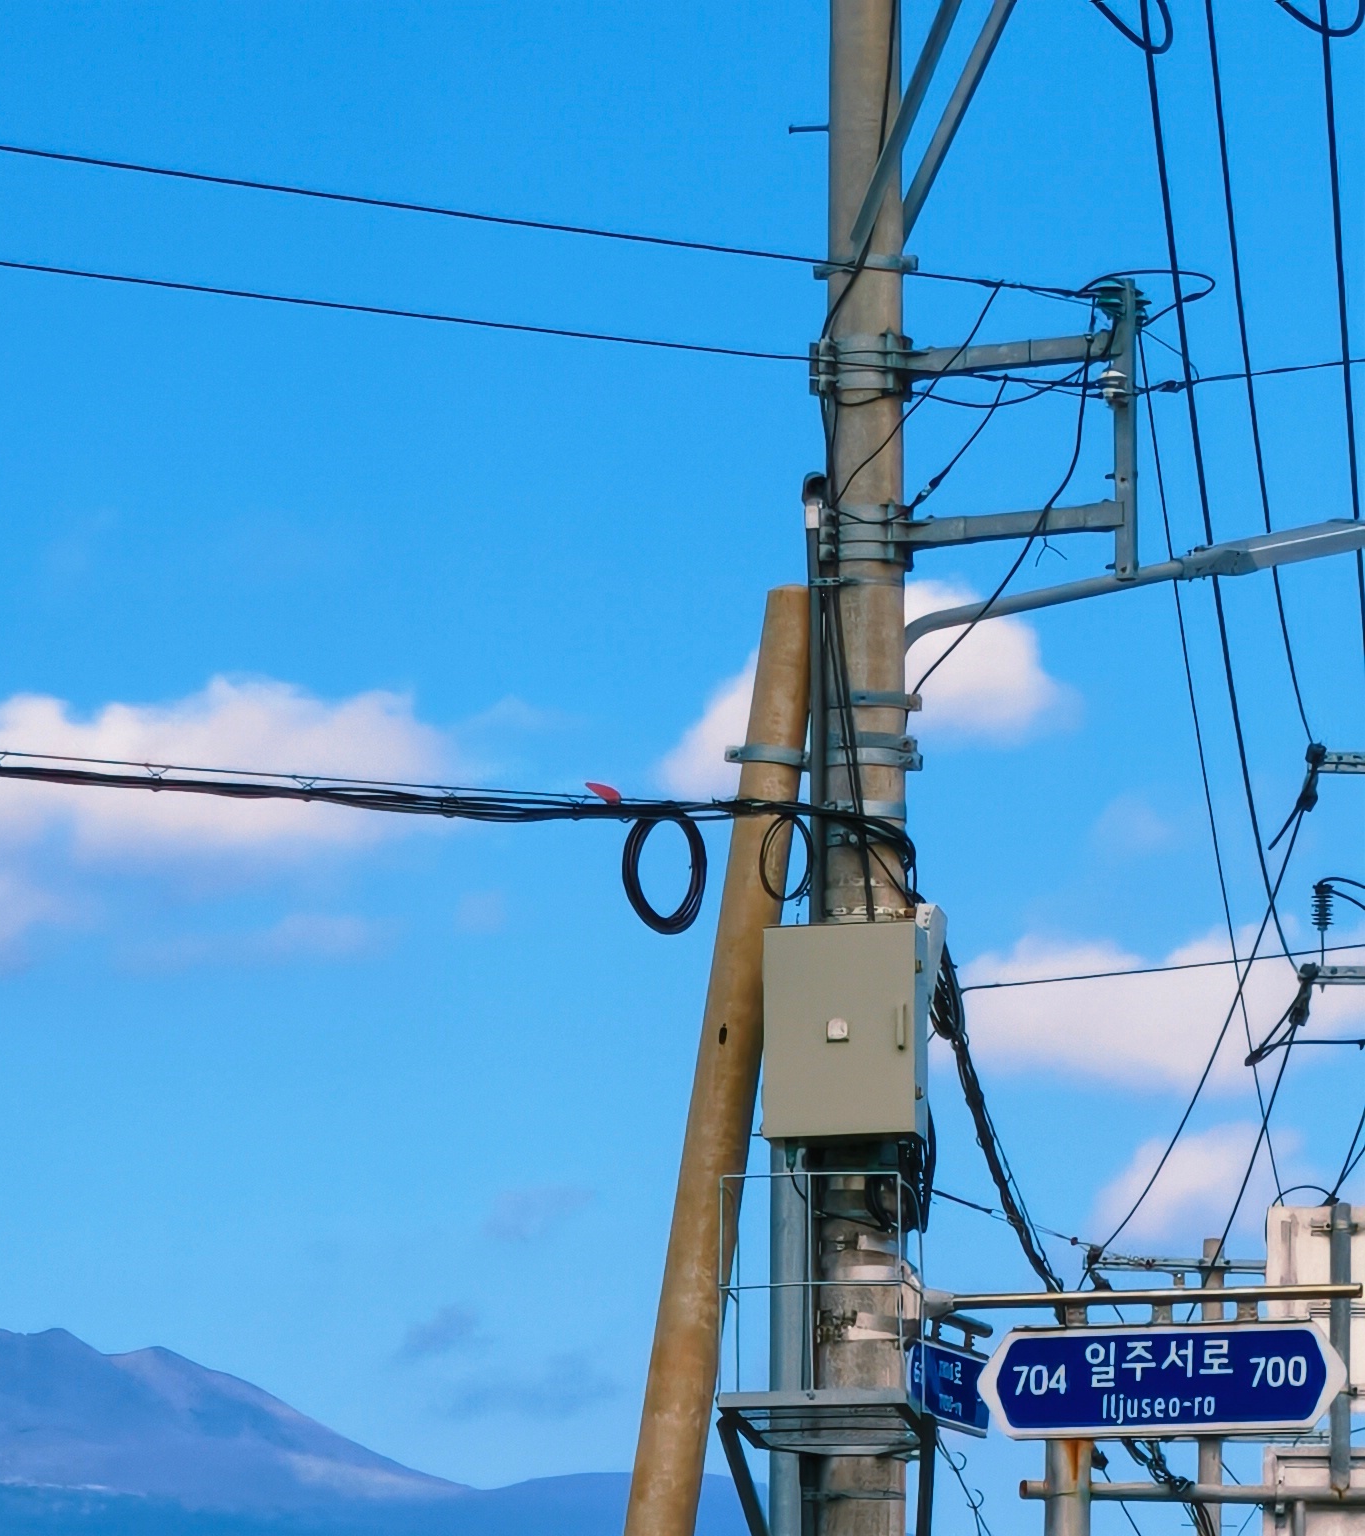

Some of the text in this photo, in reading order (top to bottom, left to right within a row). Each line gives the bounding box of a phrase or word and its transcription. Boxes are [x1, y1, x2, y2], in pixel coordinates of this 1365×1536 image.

[1013, 1339, 1307, 1395] 704 일주서로 700
[1102, 1394, 1216, 1424] Iljuseo-ro
